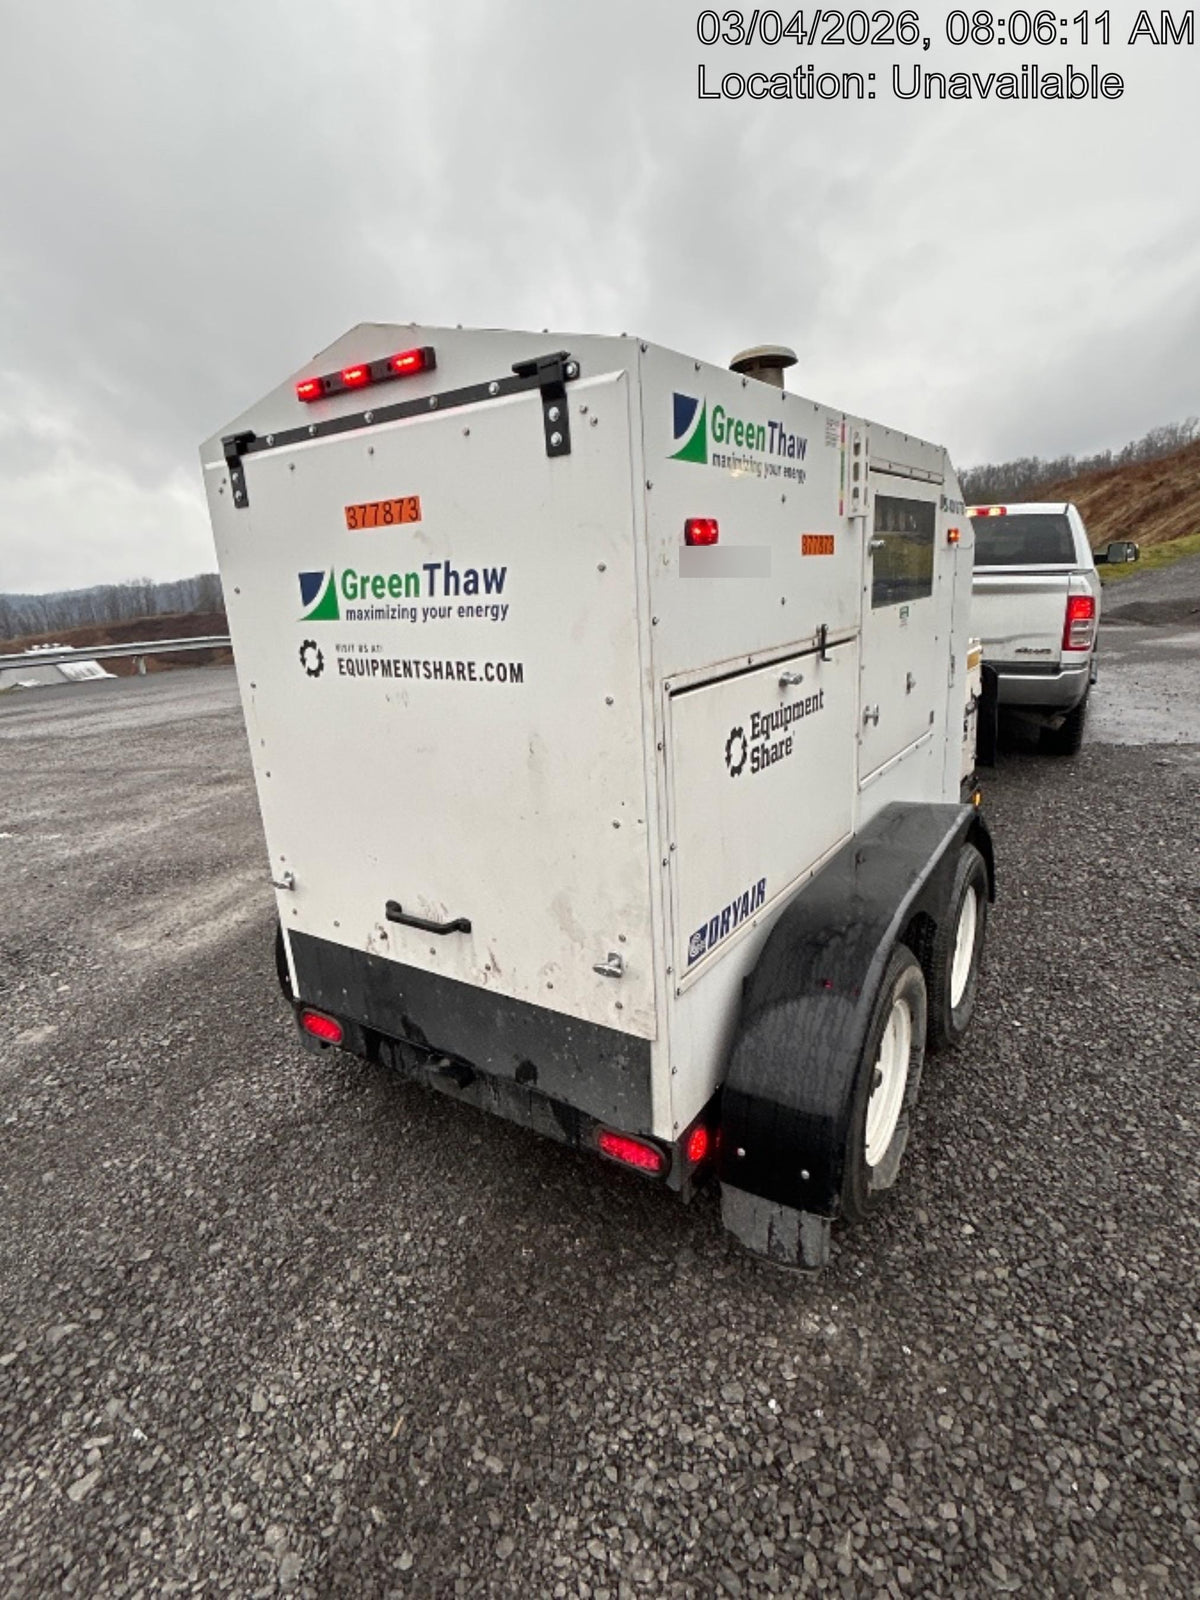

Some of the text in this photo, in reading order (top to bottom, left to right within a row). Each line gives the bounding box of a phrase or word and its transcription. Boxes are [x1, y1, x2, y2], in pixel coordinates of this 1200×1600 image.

[347, 496, 419, 529] 377873
[346, 603, 510, 623] maximizing your energy
[337, 657, 525, 683] EQUIPMENTSHARE.COM
[750, 688, 825, 741] Equipment
[750, 735, 793, 775] Share
[707, 877, 767, 951] DRYAIR
